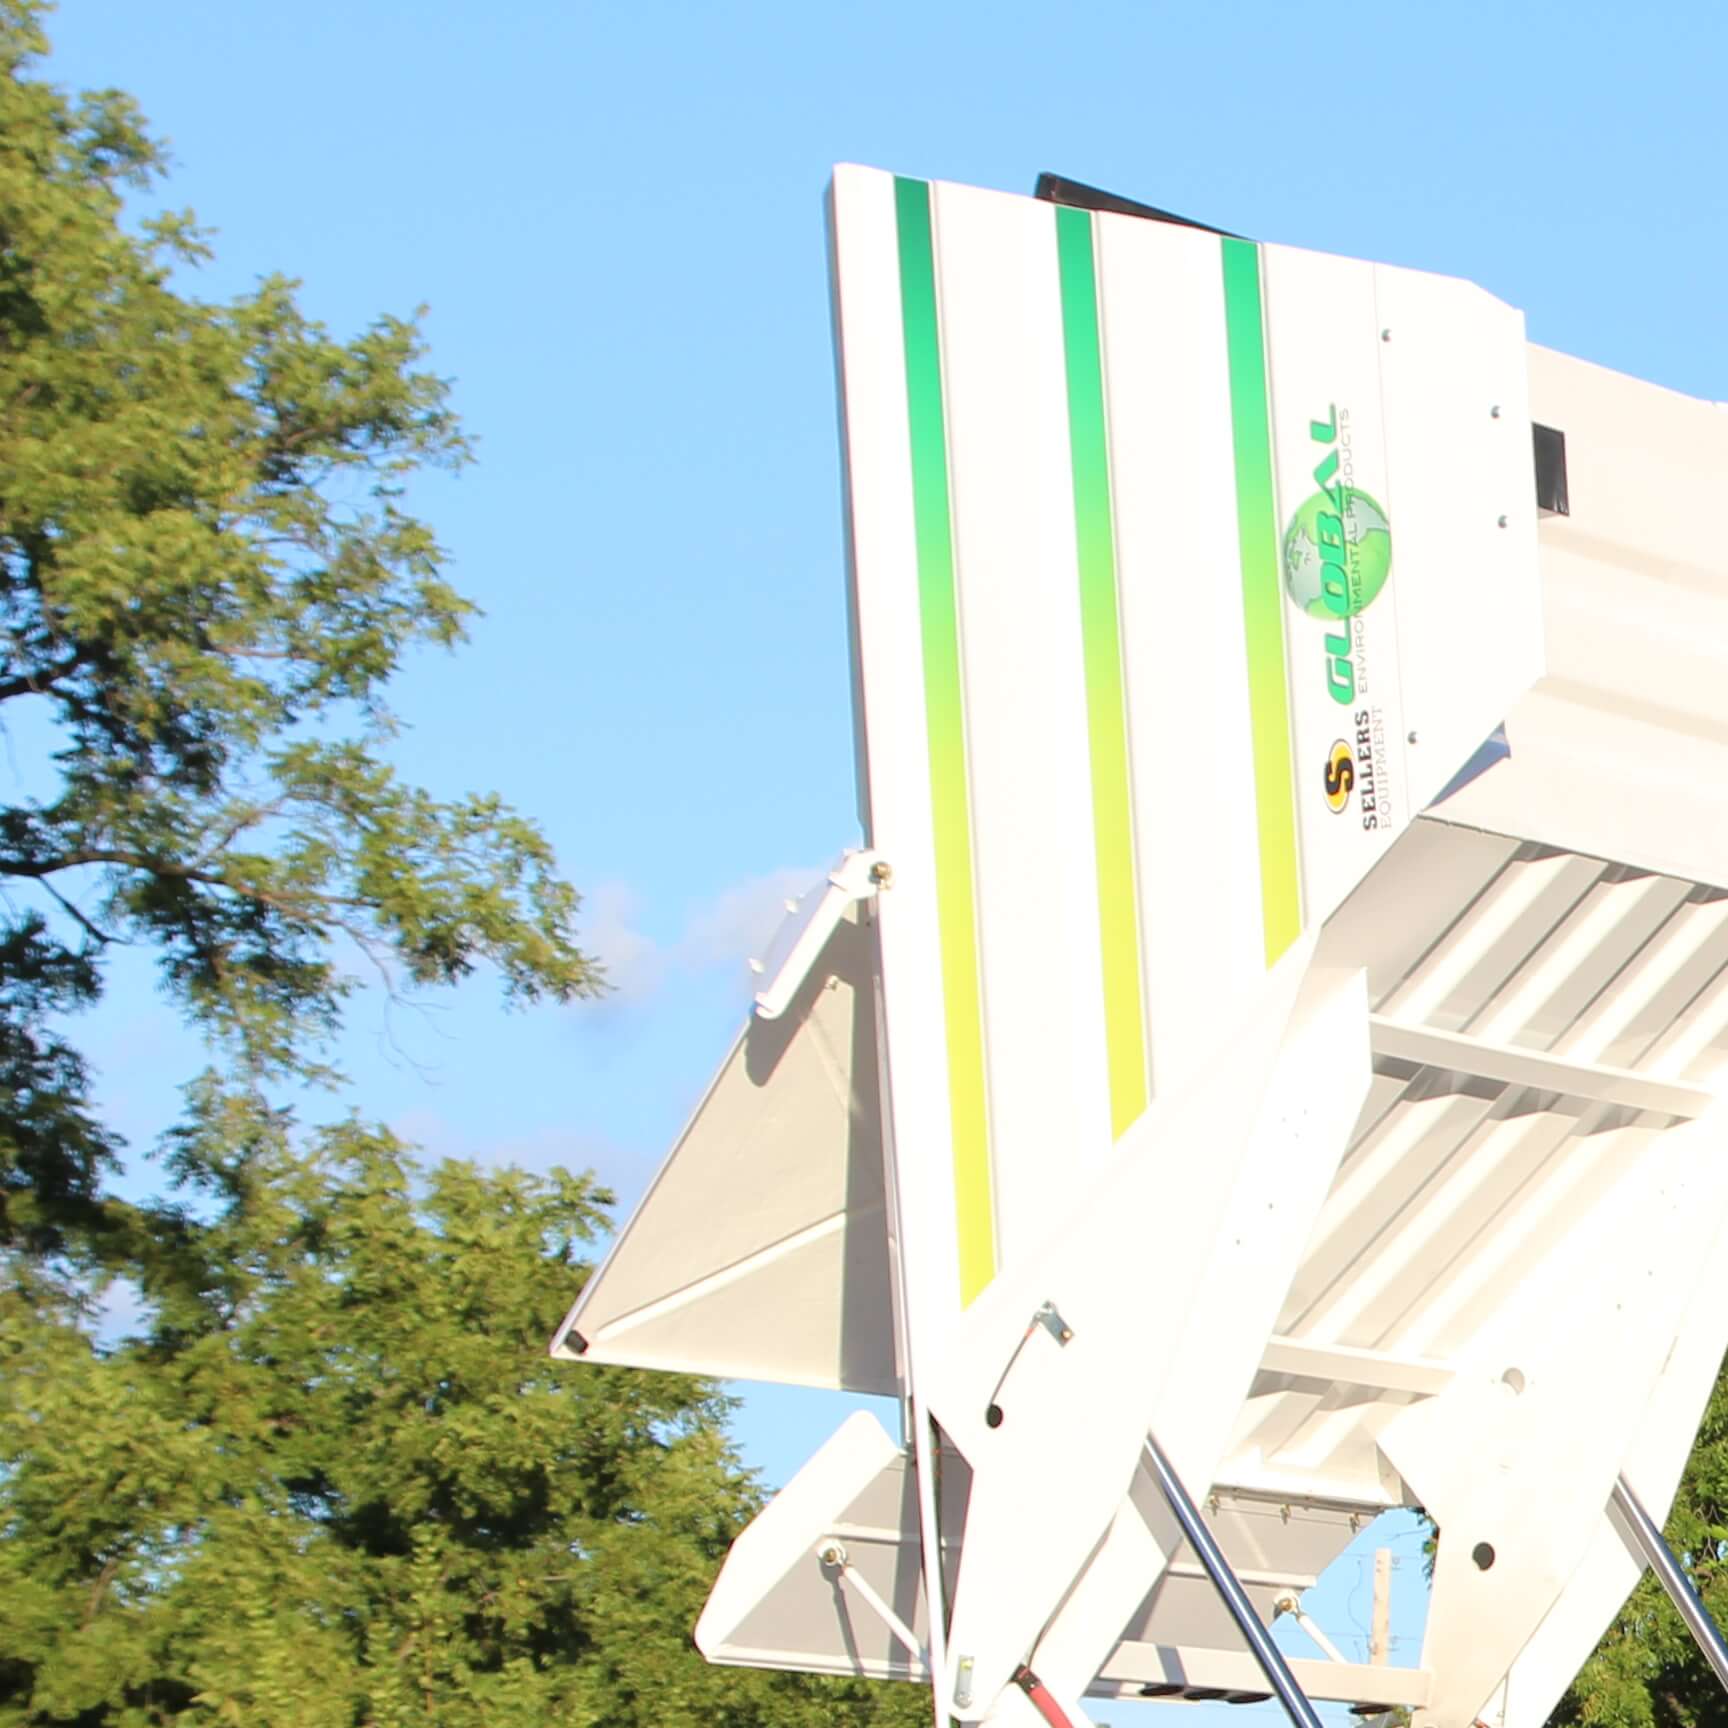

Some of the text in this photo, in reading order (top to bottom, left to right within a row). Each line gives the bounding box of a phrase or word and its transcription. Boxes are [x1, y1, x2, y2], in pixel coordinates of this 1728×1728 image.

[1310, 403, 1356, 705] GLOBAL
[1339, 408, 1368, 694] ENVIRONMENTAL PRODUCTS
[1355, 710, 1378, 831] SELLERS
[1371, 705, 1392, 830] EQUIPMENT
